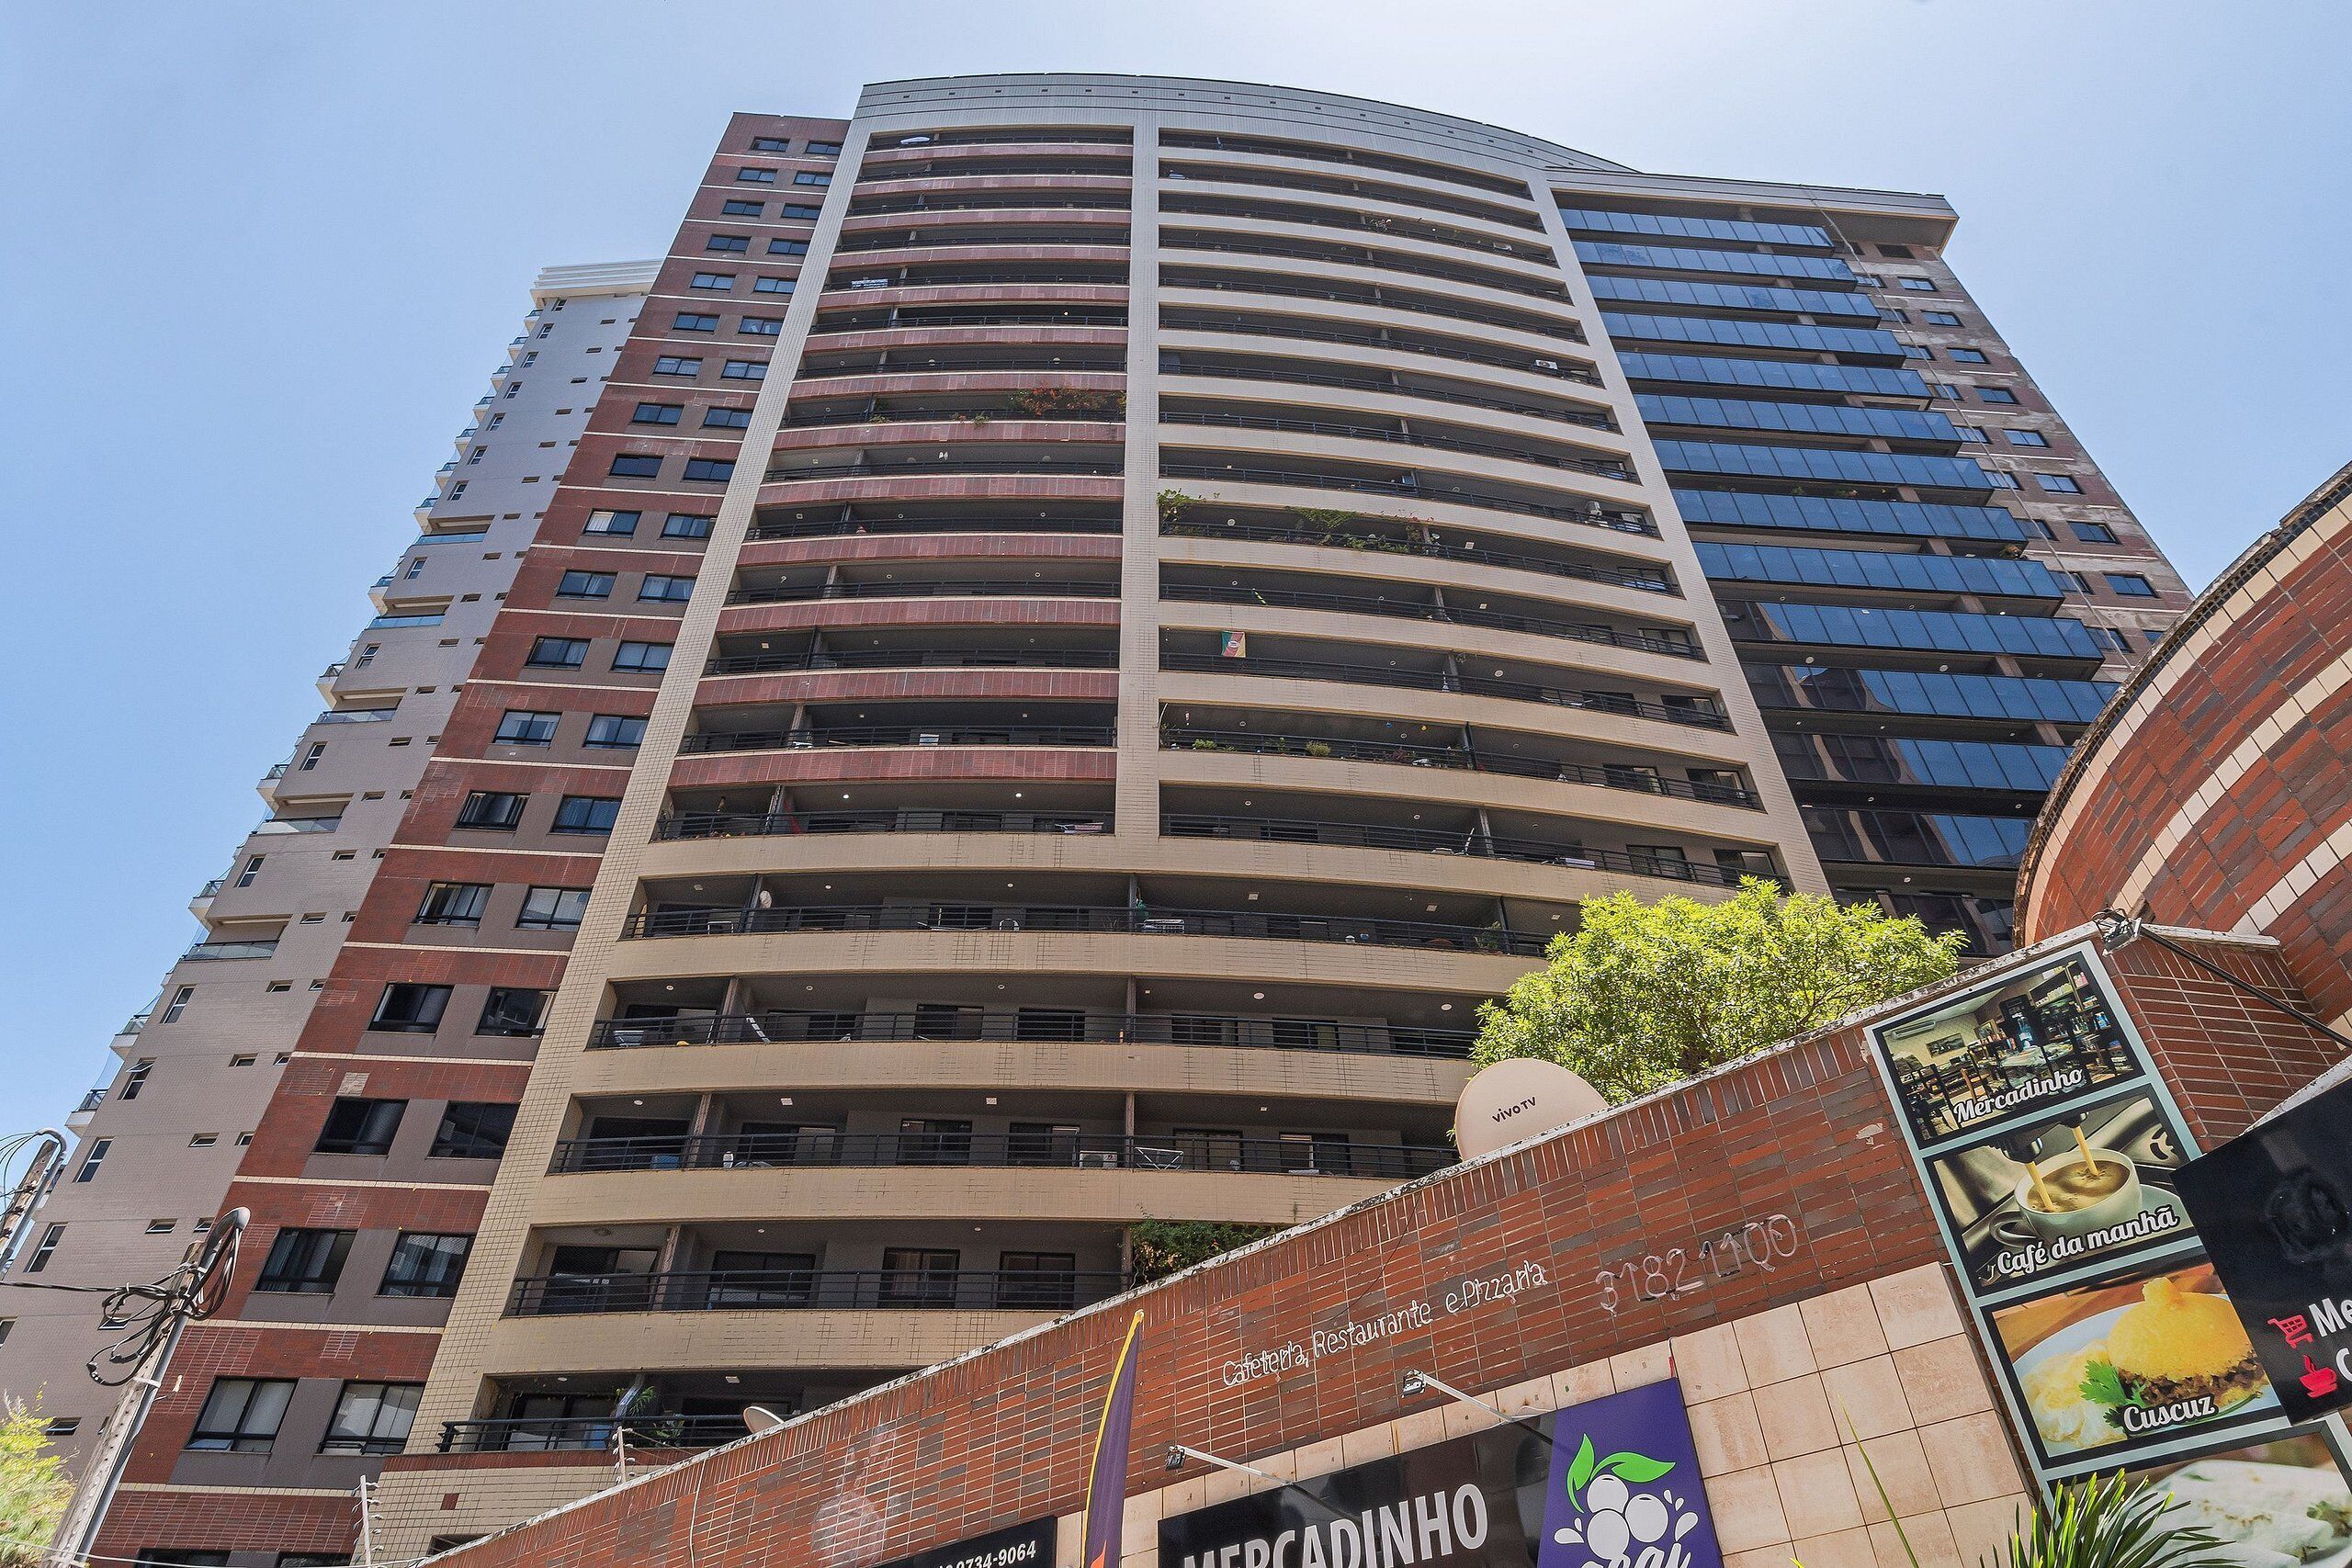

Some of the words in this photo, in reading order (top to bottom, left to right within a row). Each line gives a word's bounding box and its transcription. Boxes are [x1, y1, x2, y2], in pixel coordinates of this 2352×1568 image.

[1491, 1105, 1521, 1122] vivo
[1521, 1096, 1535, 1110] TV
[1953, 1068, 2083, 1122] Mercadinho
[1996, 1240, 2048, 1274] Café
[2052, 1238, 2084, 1258] da
[2088, 1206, 2178, 1249] manhã
[1313, 1299, 1434, 1359] Restaurante
[2123, 1396, 2215, 1432] Cuscuz
[1183, 1483, 1488, 1568] CADINHO
